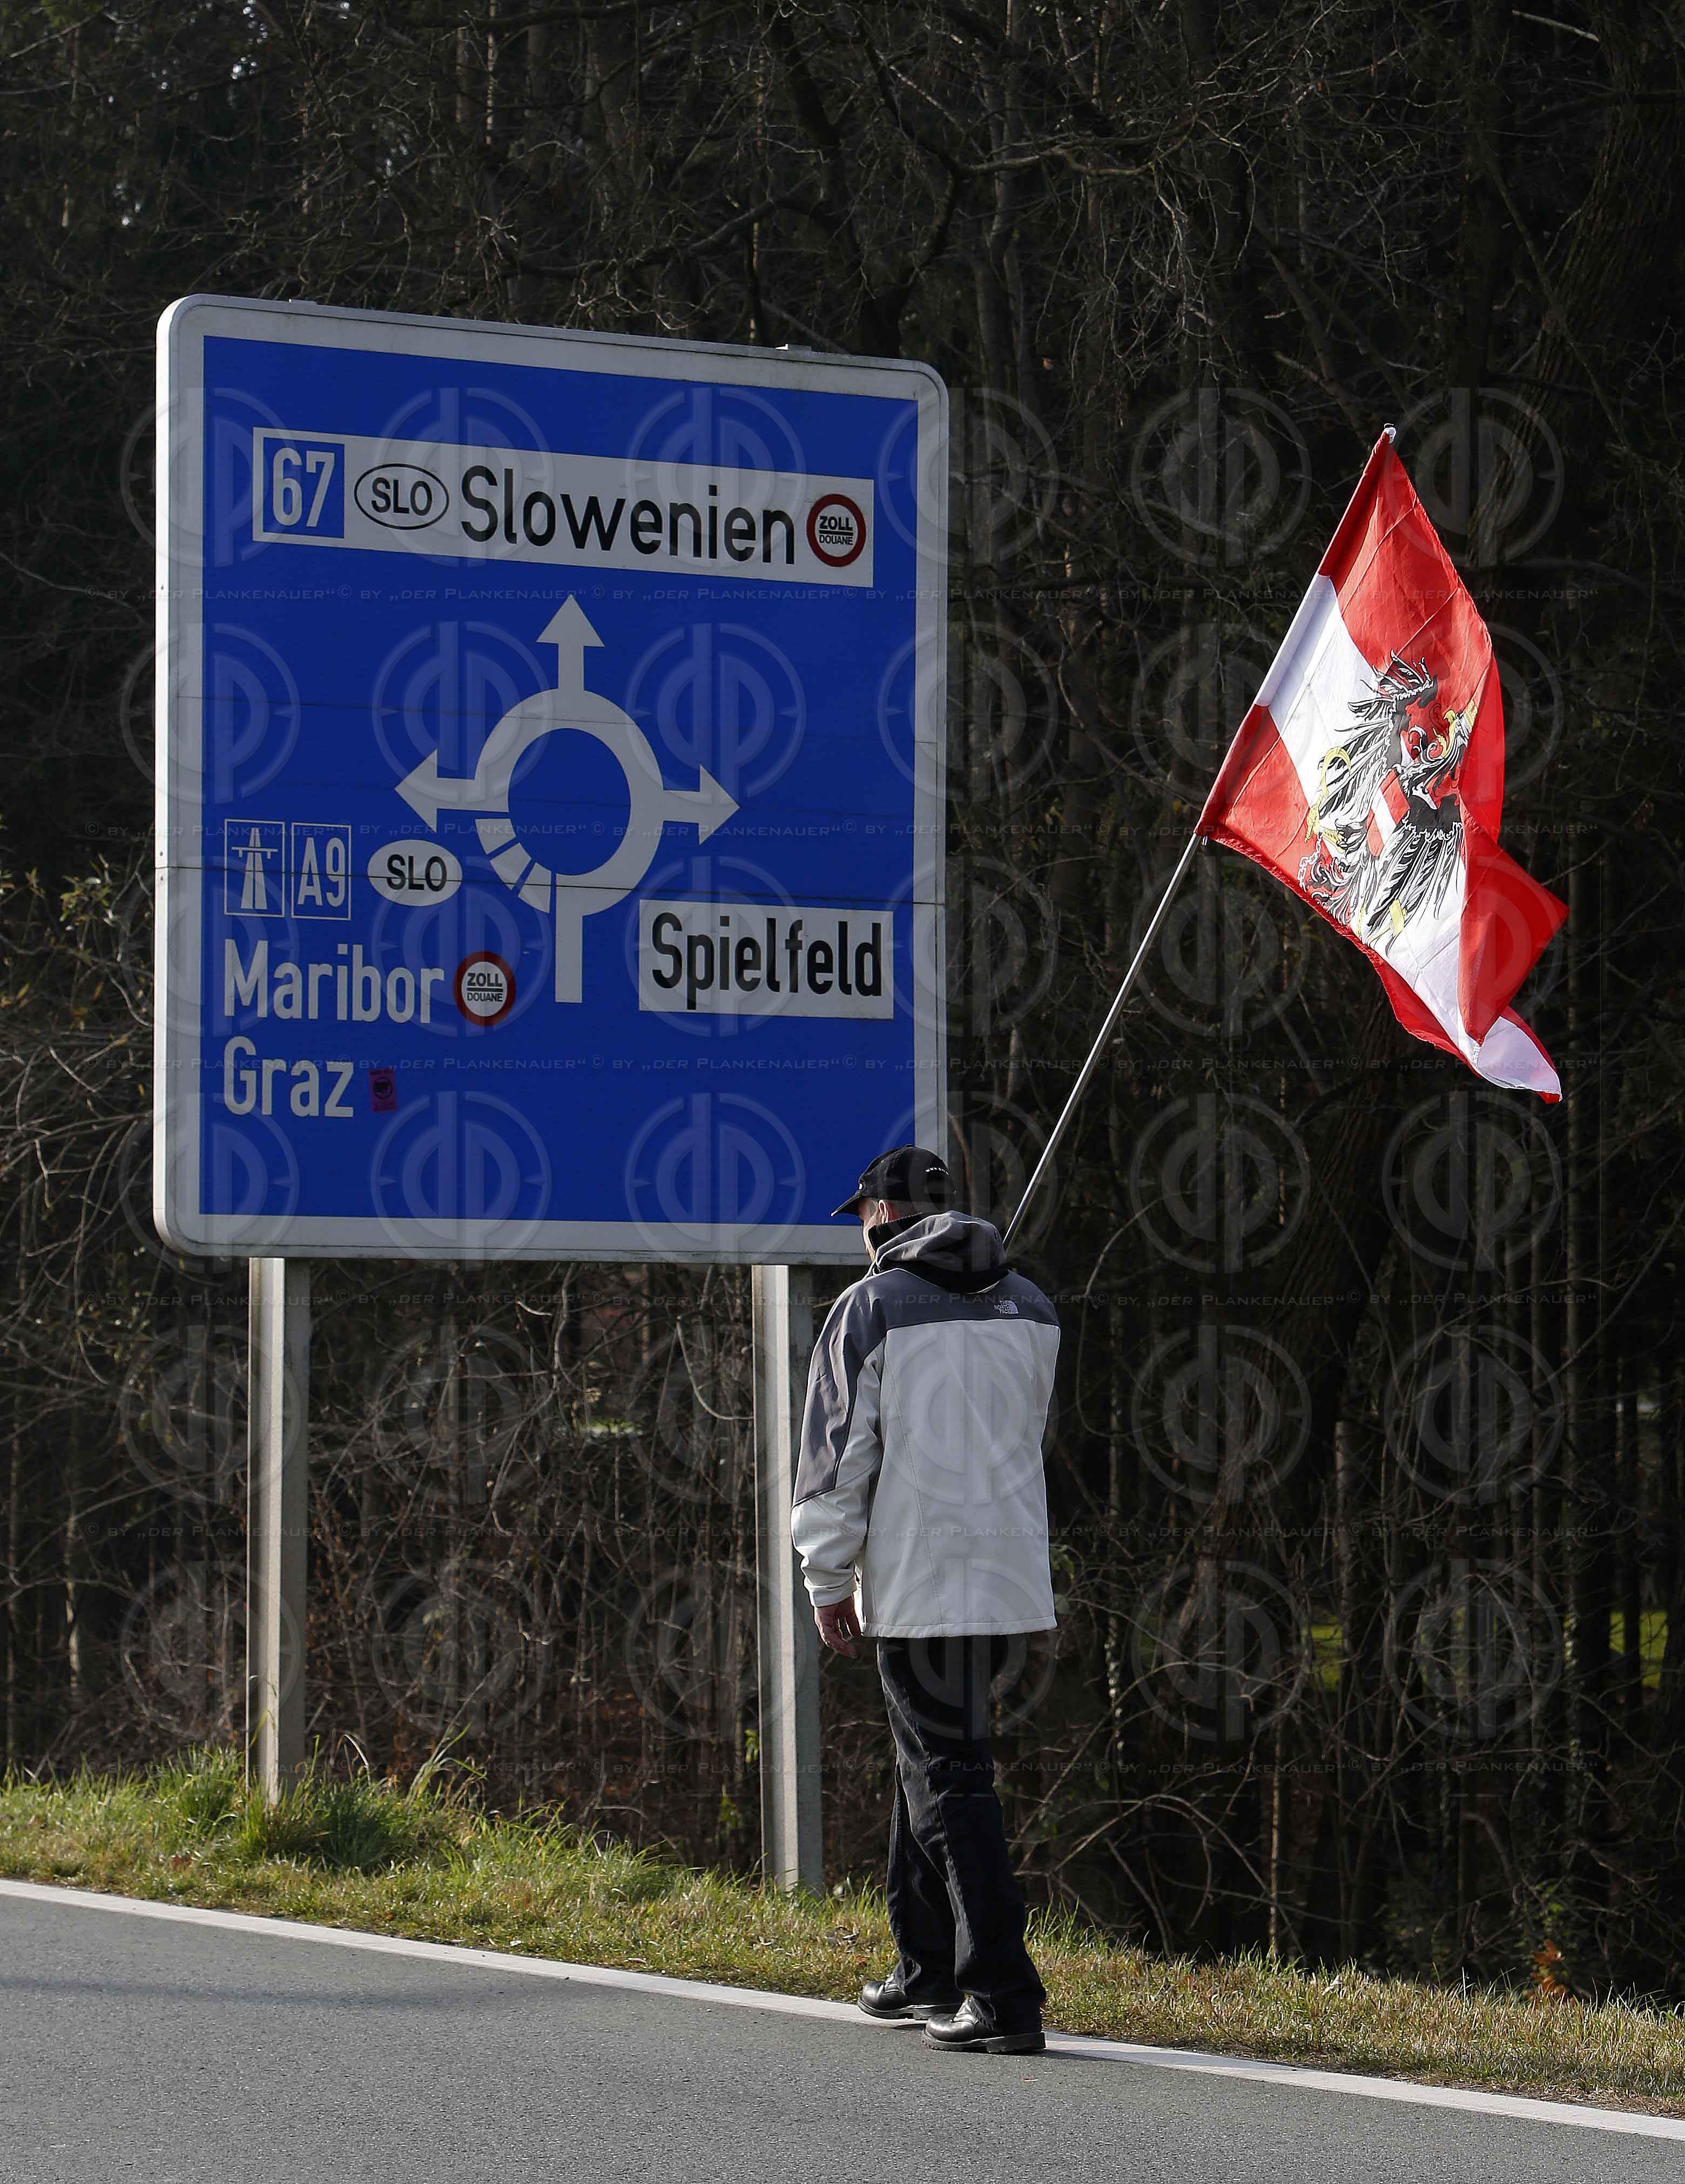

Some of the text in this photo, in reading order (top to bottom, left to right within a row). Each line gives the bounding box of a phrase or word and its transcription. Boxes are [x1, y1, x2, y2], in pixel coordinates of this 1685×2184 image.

[273, 448, 334, 527] 67
[372, 477, 432, 516] SLO
[461, 465, 795, 565] Slowenien
[819, 515, 853, 531] ZOLL
[819, 535, 853, 545] DOUANE
[298, 838, 345, 907] A9
[387, 854, 447, 892] SLO
[224, 939, 444, 1023] Maribor
[467, 973, 503, 987] ZOLL
[652, 912, 882, 1010] Spielfeld
[467, 993, 503, 1002] DOUANE
[224, 1036, 353, 1117] Graz
